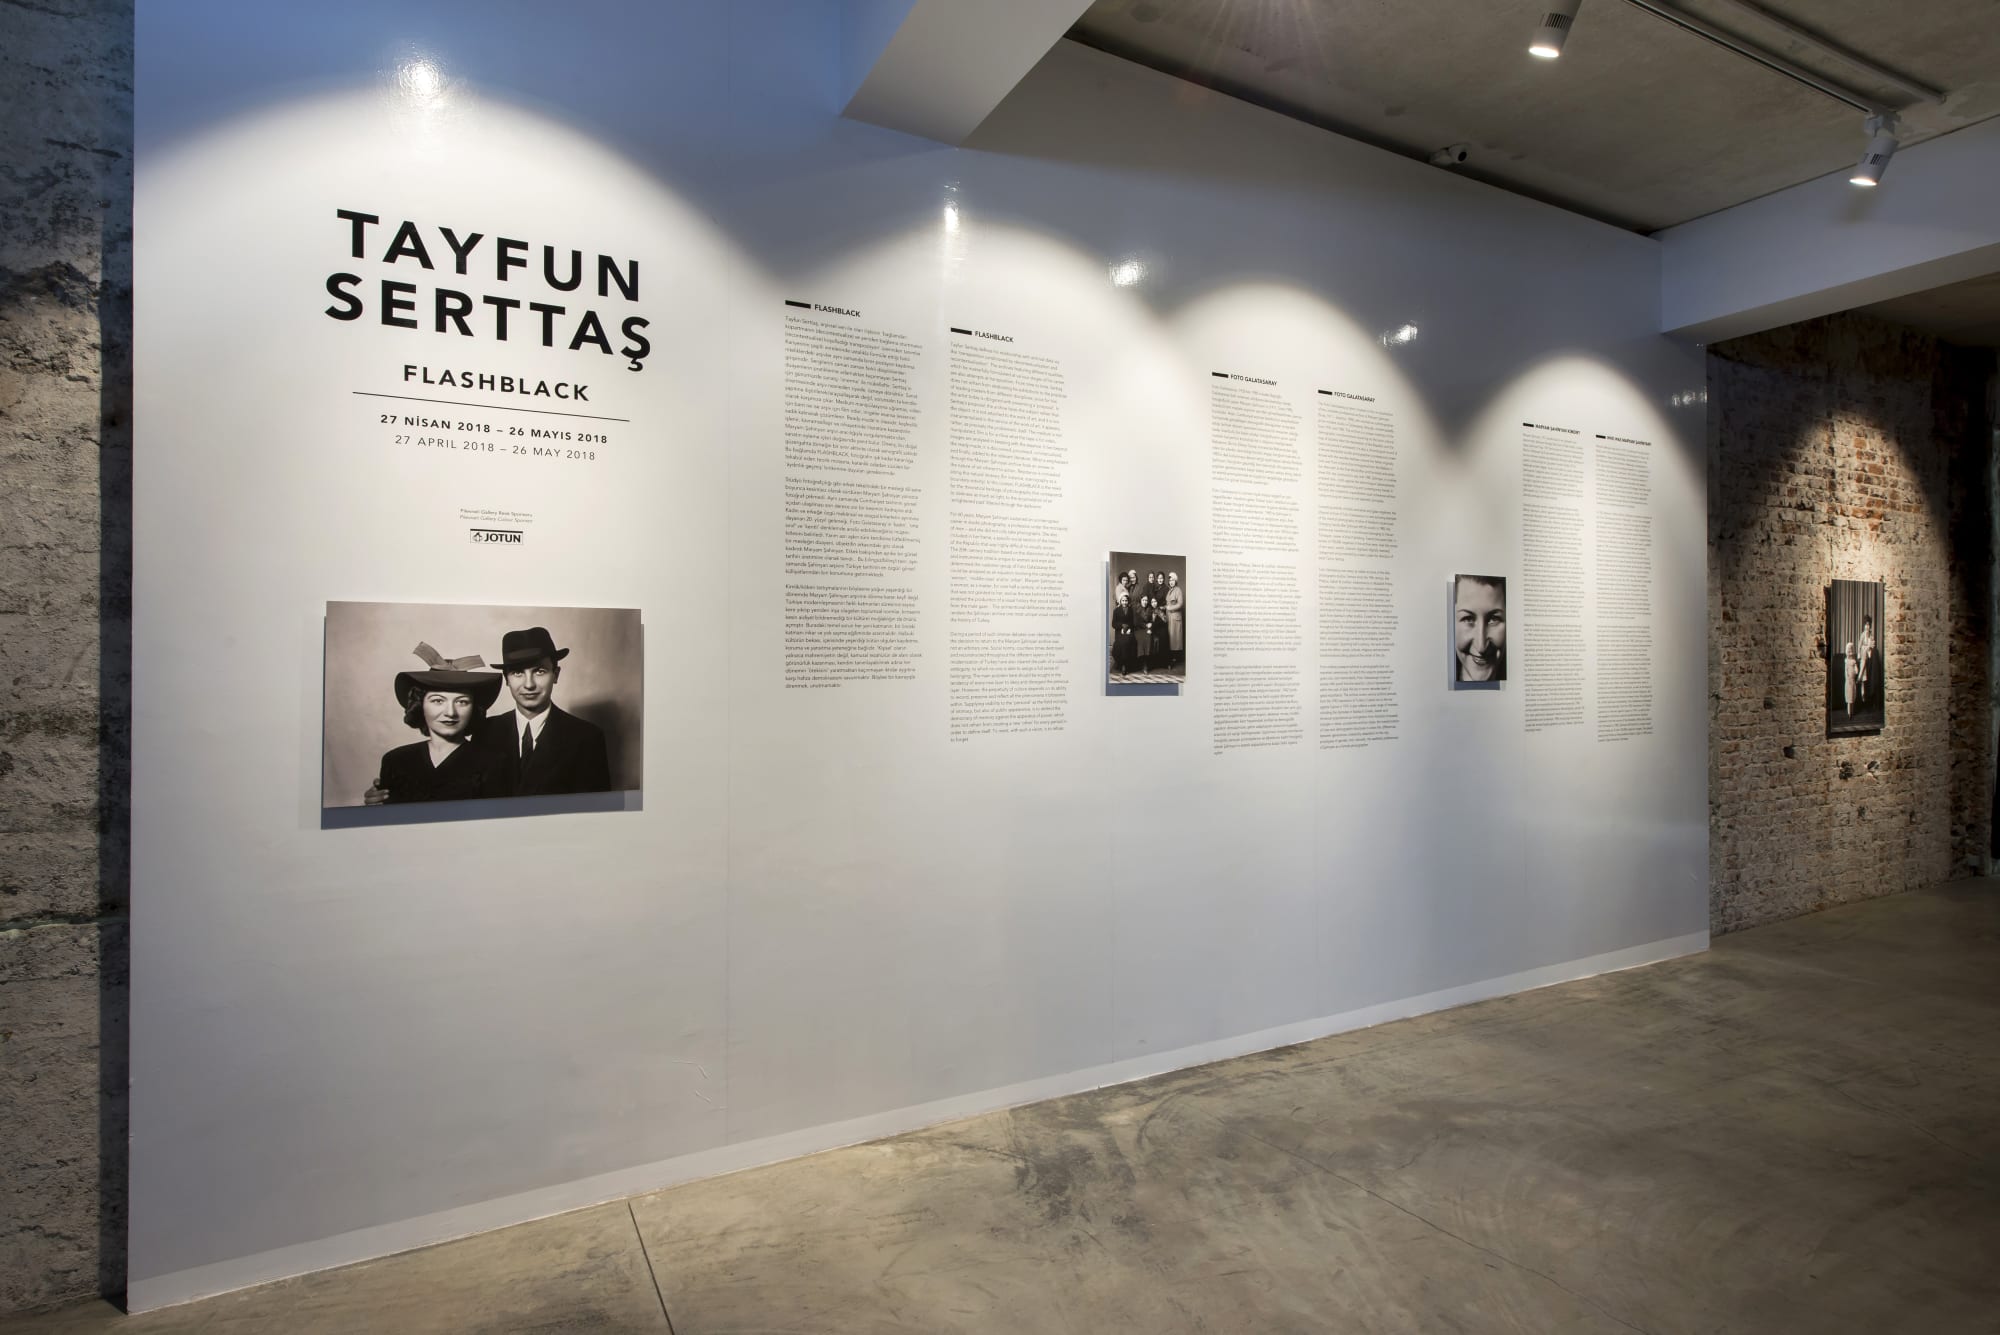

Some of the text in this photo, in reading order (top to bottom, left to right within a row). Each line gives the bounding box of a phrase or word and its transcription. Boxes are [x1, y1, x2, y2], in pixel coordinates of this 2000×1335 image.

[337, 209, 638, 302] TAYFUN
[325, 272, 651, 372] SERTTAŞ
[814, 304, 860, 317] FLASHBLACK
[975, 331, 1014, 342] FLASHBLACK
[404, 365, 589, 402] FLASHBLACK
[1245, 376, 1277, 386] GALATASARAY
[381, 415, 397, 425] 27
[404, 416, 451, 429] NİSAN
[457, 422, 490, 433] 2018
[510, 427, 524, 436] 26
[531, 429, 572, 441] MAYIS
[578, 432, 608, 444] 2018
[395, 435, 410, 445] 27
[418, 437, 456, 449] APRIL
[463, 441, 494, 452] 2018
[512, 445, 526, 455] 26
[533, 447, 561, 458] MAY
[566, 450, 595, 461] 2018
[484, 533, 520, 542] JOTUN
